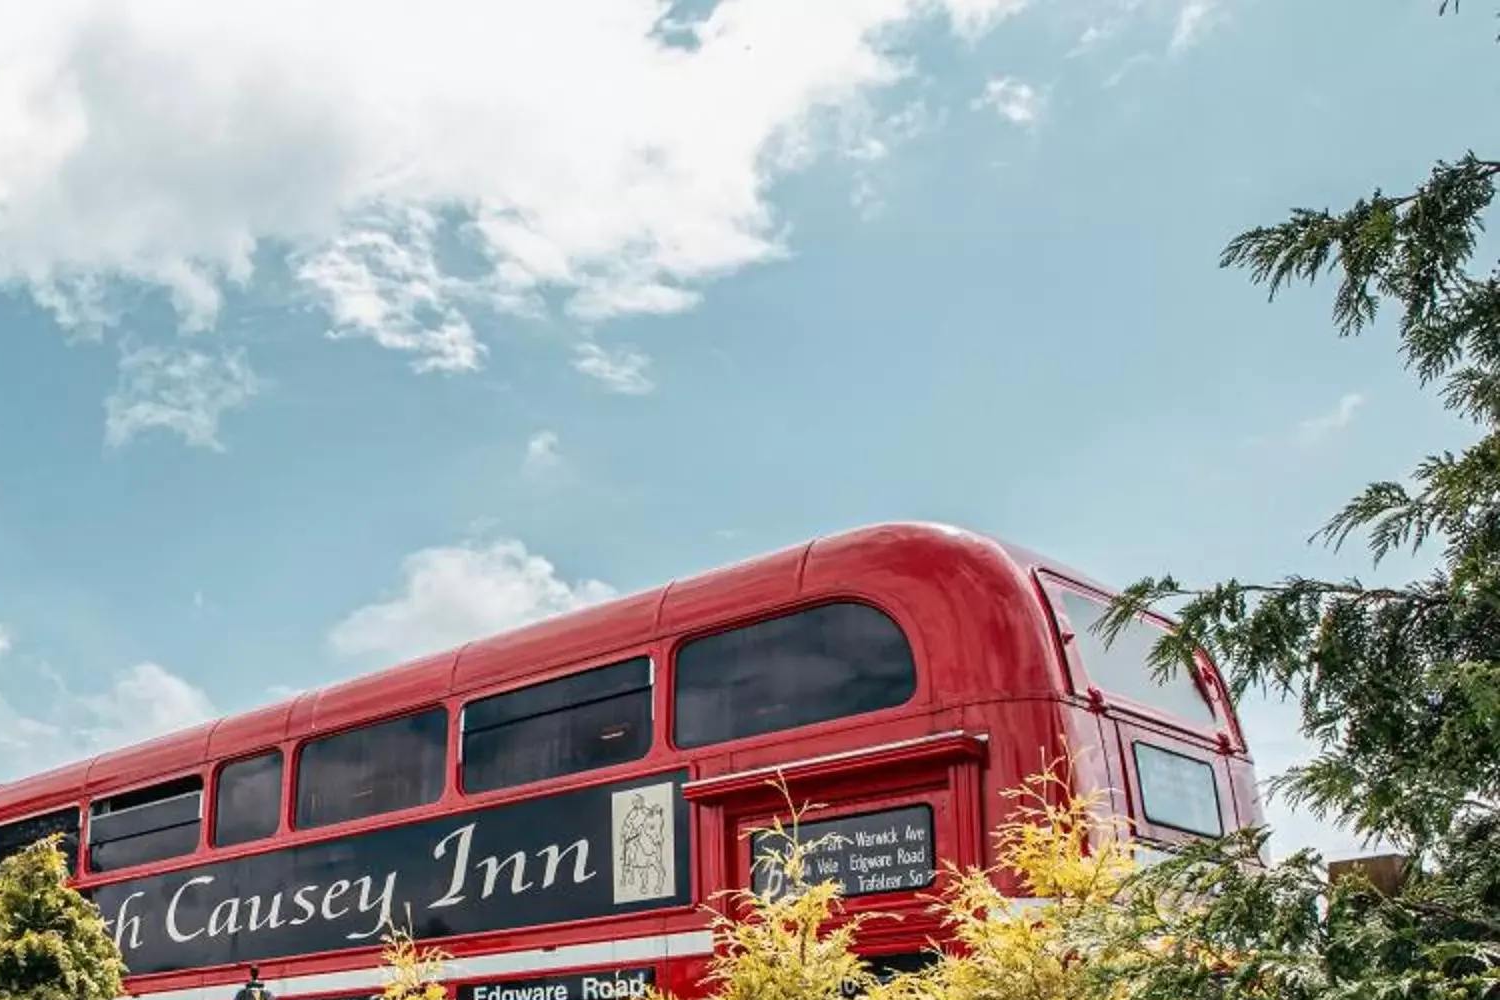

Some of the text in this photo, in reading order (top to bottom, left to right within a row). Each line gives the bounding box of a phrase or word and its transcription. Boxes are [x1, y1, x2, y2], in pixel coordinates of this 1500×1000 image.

[855, 826, 898, 848] Warwick
[905, 825, 925, 842] Ave
[850, 853, 892, 873] Edgware
[897, 846, 925, 865] Road
[165, 871, 397, 939] Causey
[428, 823, 596, 909] Inn
[582, 972, 646, 1000] Road
